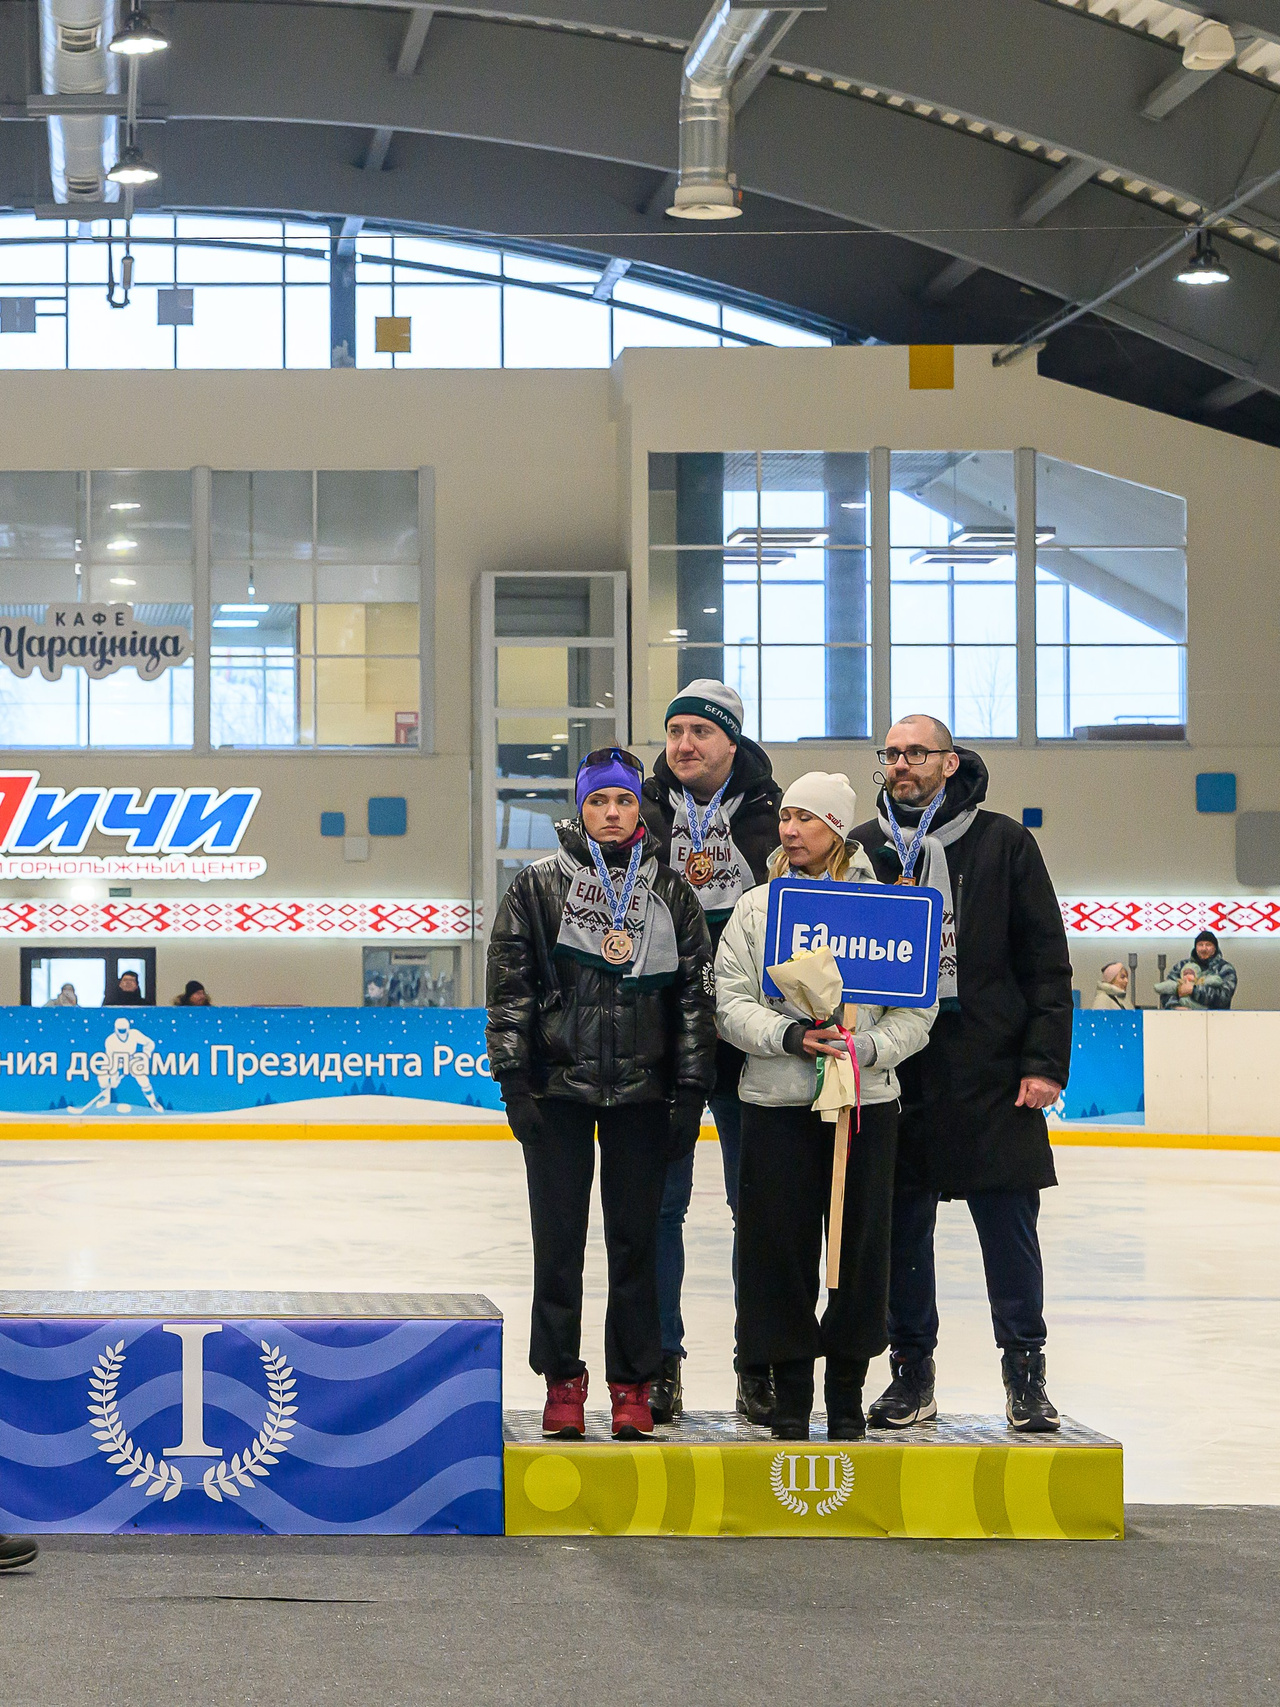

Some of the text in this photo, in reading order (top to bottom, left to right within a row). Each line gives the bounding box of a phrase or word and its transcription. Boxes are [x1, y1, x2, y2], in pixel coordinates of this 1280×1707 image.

[55, 612, 125, 627] КАФЕ
[9, 858, 186, 874] ГОРНОЛЫЖНЫЙ
[192, 862, 261, 878] ЦЕНТР
[791, 922, 913, 963] Единые
[66, 1051, 200, 1082] делами
[210, 1044, 422, 1084] Президента
[784, 1454, 841, 1492] III
